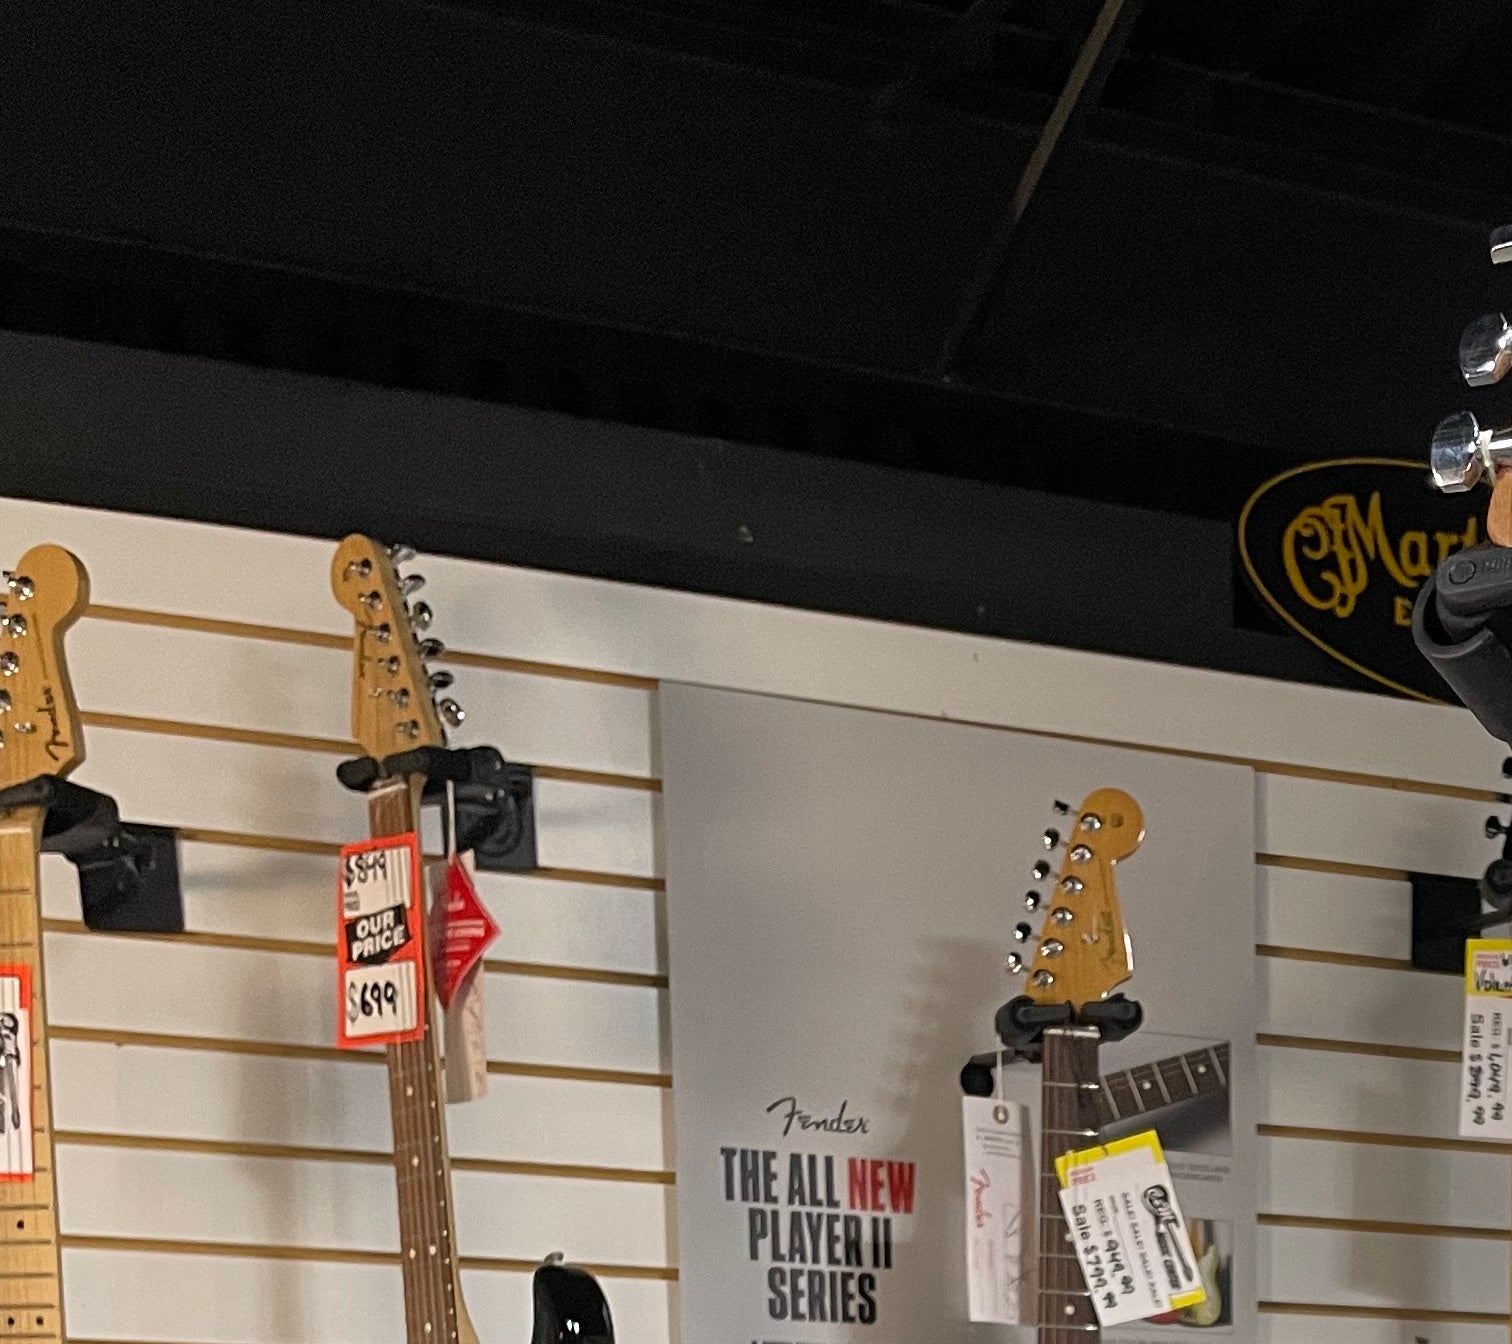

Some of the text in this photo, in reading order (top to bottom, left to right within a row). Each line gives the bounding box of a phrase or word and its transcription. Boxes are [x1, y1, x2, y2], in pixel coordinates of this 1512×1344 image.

[351, 924, 405, 962] PRICE
[356, 909, 395, 938] OUR
[346, 980, 398, 1023] $699
[1470, 1014, 1485, 1048] Sale
[767, 1096, 870, 1137] Fender
[720, 1145, 917, 1215] THE ALL NEW
[748, 1207, 893, 1270] PLAYER II
[1072, 1204, 1091, 1241] Sale
[767, 1266, 878, 1326] SERIES
